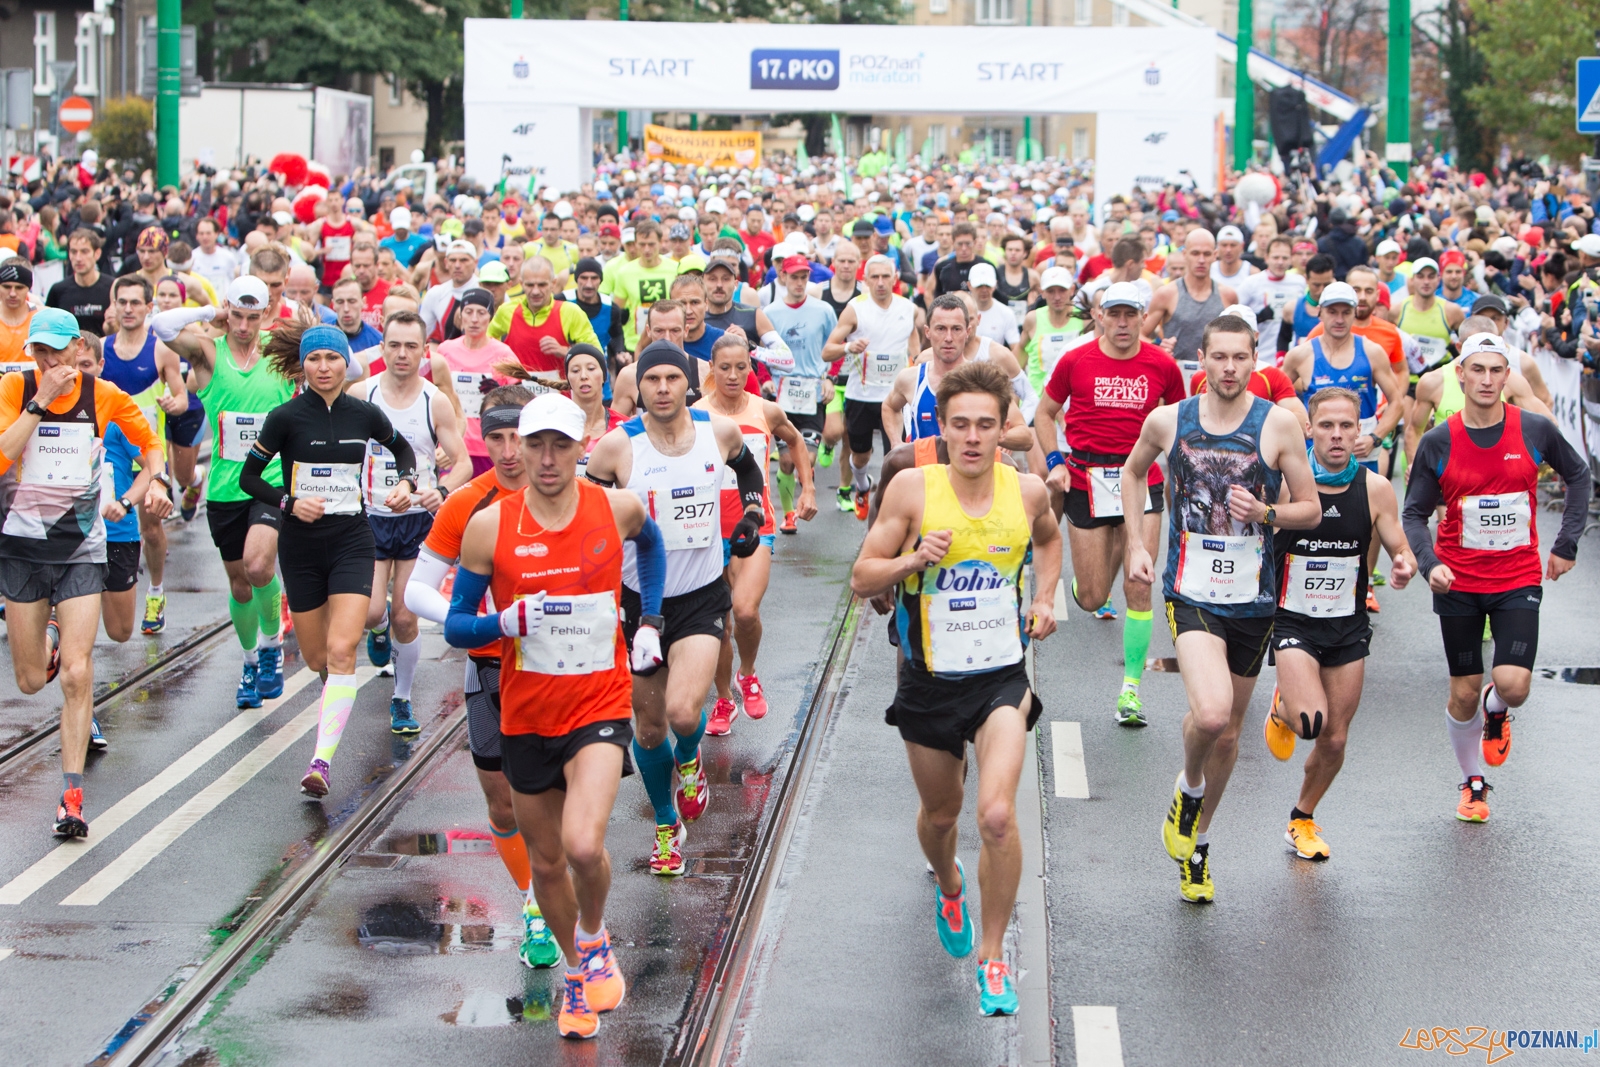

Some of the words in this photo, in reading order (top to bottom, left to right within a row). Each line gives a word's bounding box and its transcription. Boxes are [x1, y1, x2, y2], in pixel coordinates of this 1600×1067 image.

[609, 58, 694, 77] START
[757, 58, 835, 81] 17.PKO
[977, 62, 1064, 81] START
[849, 70, 921, 84] maraton
[719, 137, 756, 148] KLUB
[664, 148, 731, 161] BIEGACZA
[877, 364, 898, 372] 1037
[1095, 375, 1139, 387] DRUŻYNA
[1094, 386, 1148, 400] SZPIKU
[240, 430, 262, 441] 63
[39, 445, 79, 455] Pobłocki
[651, 465, 667, 474] asics
[673, 488, 693, 498] 17.PKO
[674, 501, 715, 520] 2977
[1480, 512, 1517, 527] 5915
[683, 521, 710, 530] Bartosz
[1204, 542, 1224, 550] 17.PKO
[1309, 540, 1359, 552] gtenta.lt
[1211, 559, 1235, 575] 83
[521, 571, 547, 579] FEHLAU
[1210, 576, 1234, 585] Marcin
[1304, 577, 1345, 591] 6737
[951, 600, 976, 608] 17.PKO
[550, 625, 591, 635] Fehlau
[946, 617, 1006, 632] ZABLOCKI
[567, 644, 574, 652] 3
